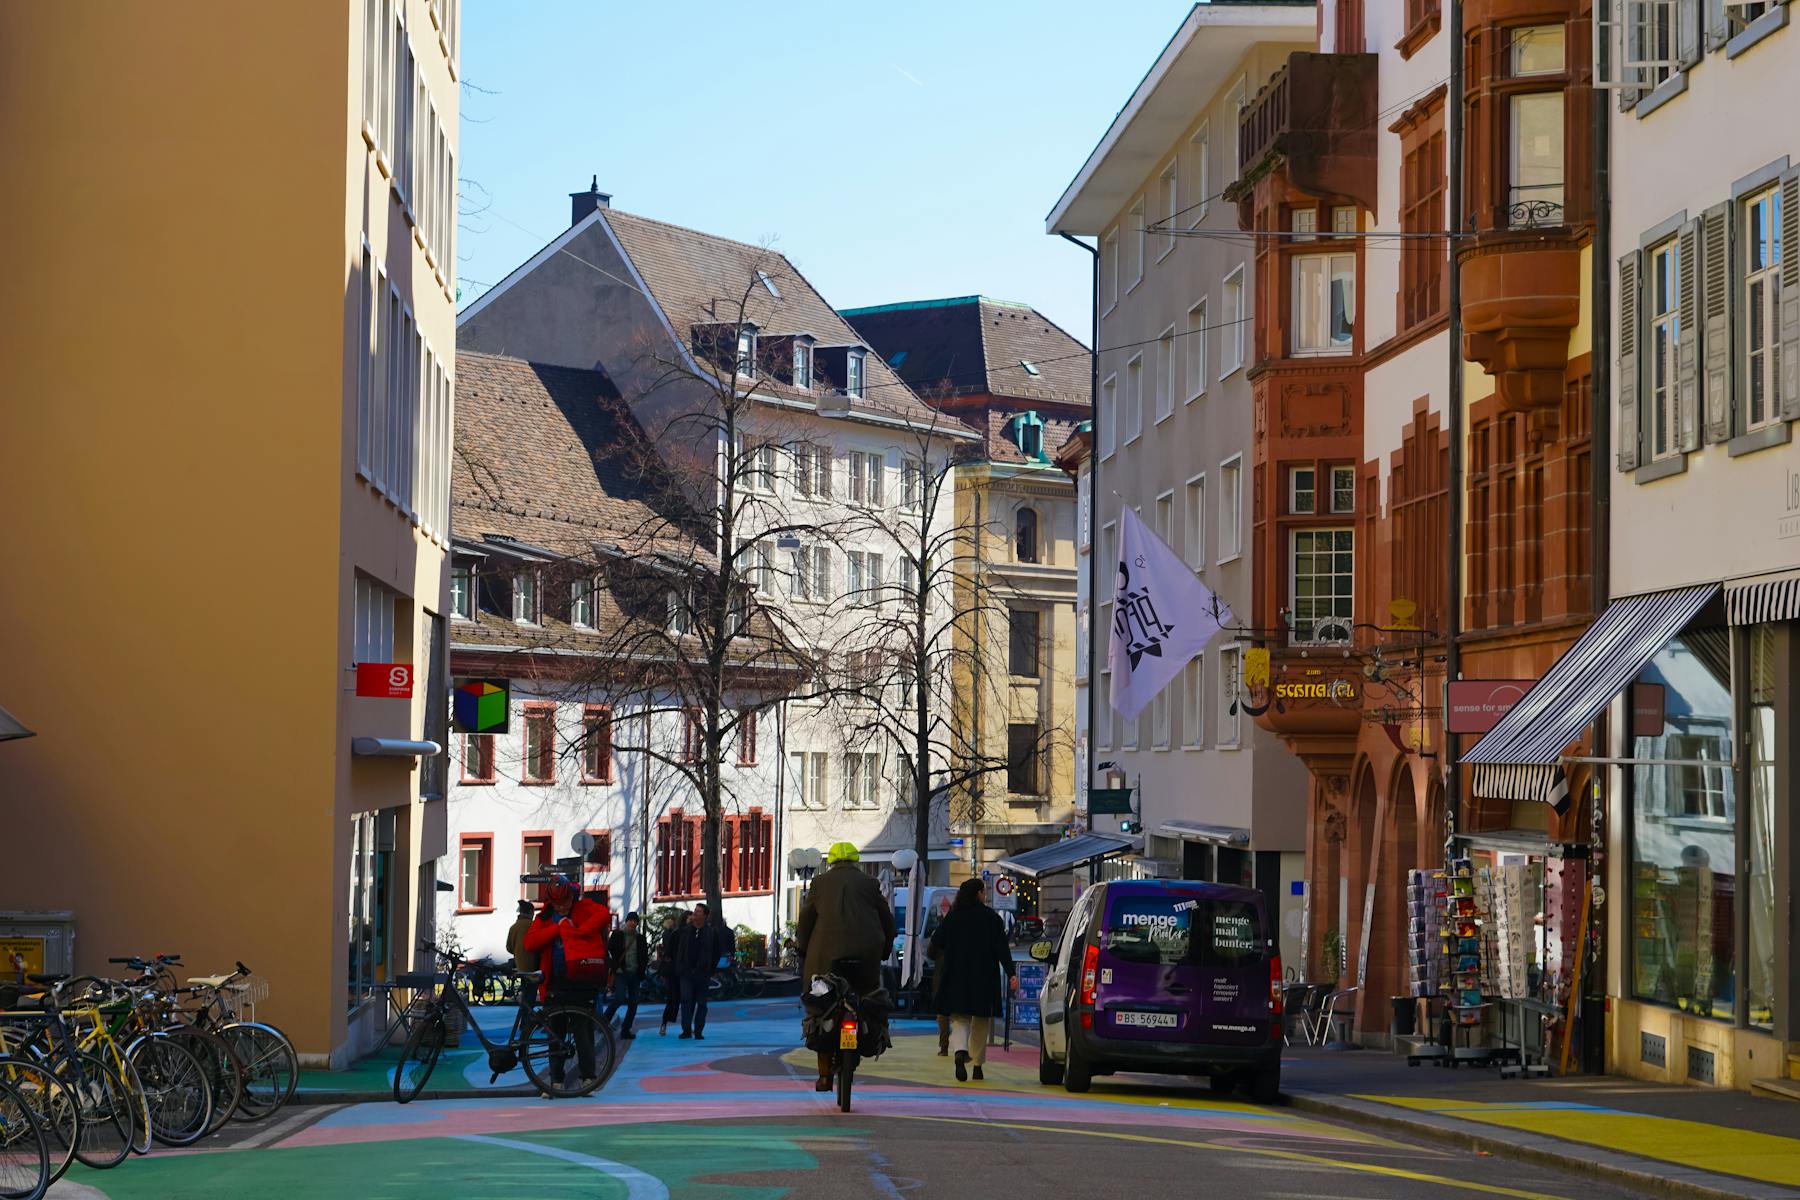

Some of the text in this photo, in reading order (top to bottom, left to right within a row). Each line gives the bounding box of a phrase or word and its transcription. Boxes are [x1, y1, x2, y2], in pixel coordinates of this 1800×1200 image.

[1453, 705, 1480, 713] sense
[1482, 703, 1495, 712] for
[1122, 913, 1177, 929] menge
[1215, 916, 1250, 927] menge
[1215, 927, 1239, 937] malt
[1215, 937, 1253, 950] bunter.
[1124, 1013, 1169, 1026] BS 56944
[1212, 1024, 1256, 1032] www.menge.ch
